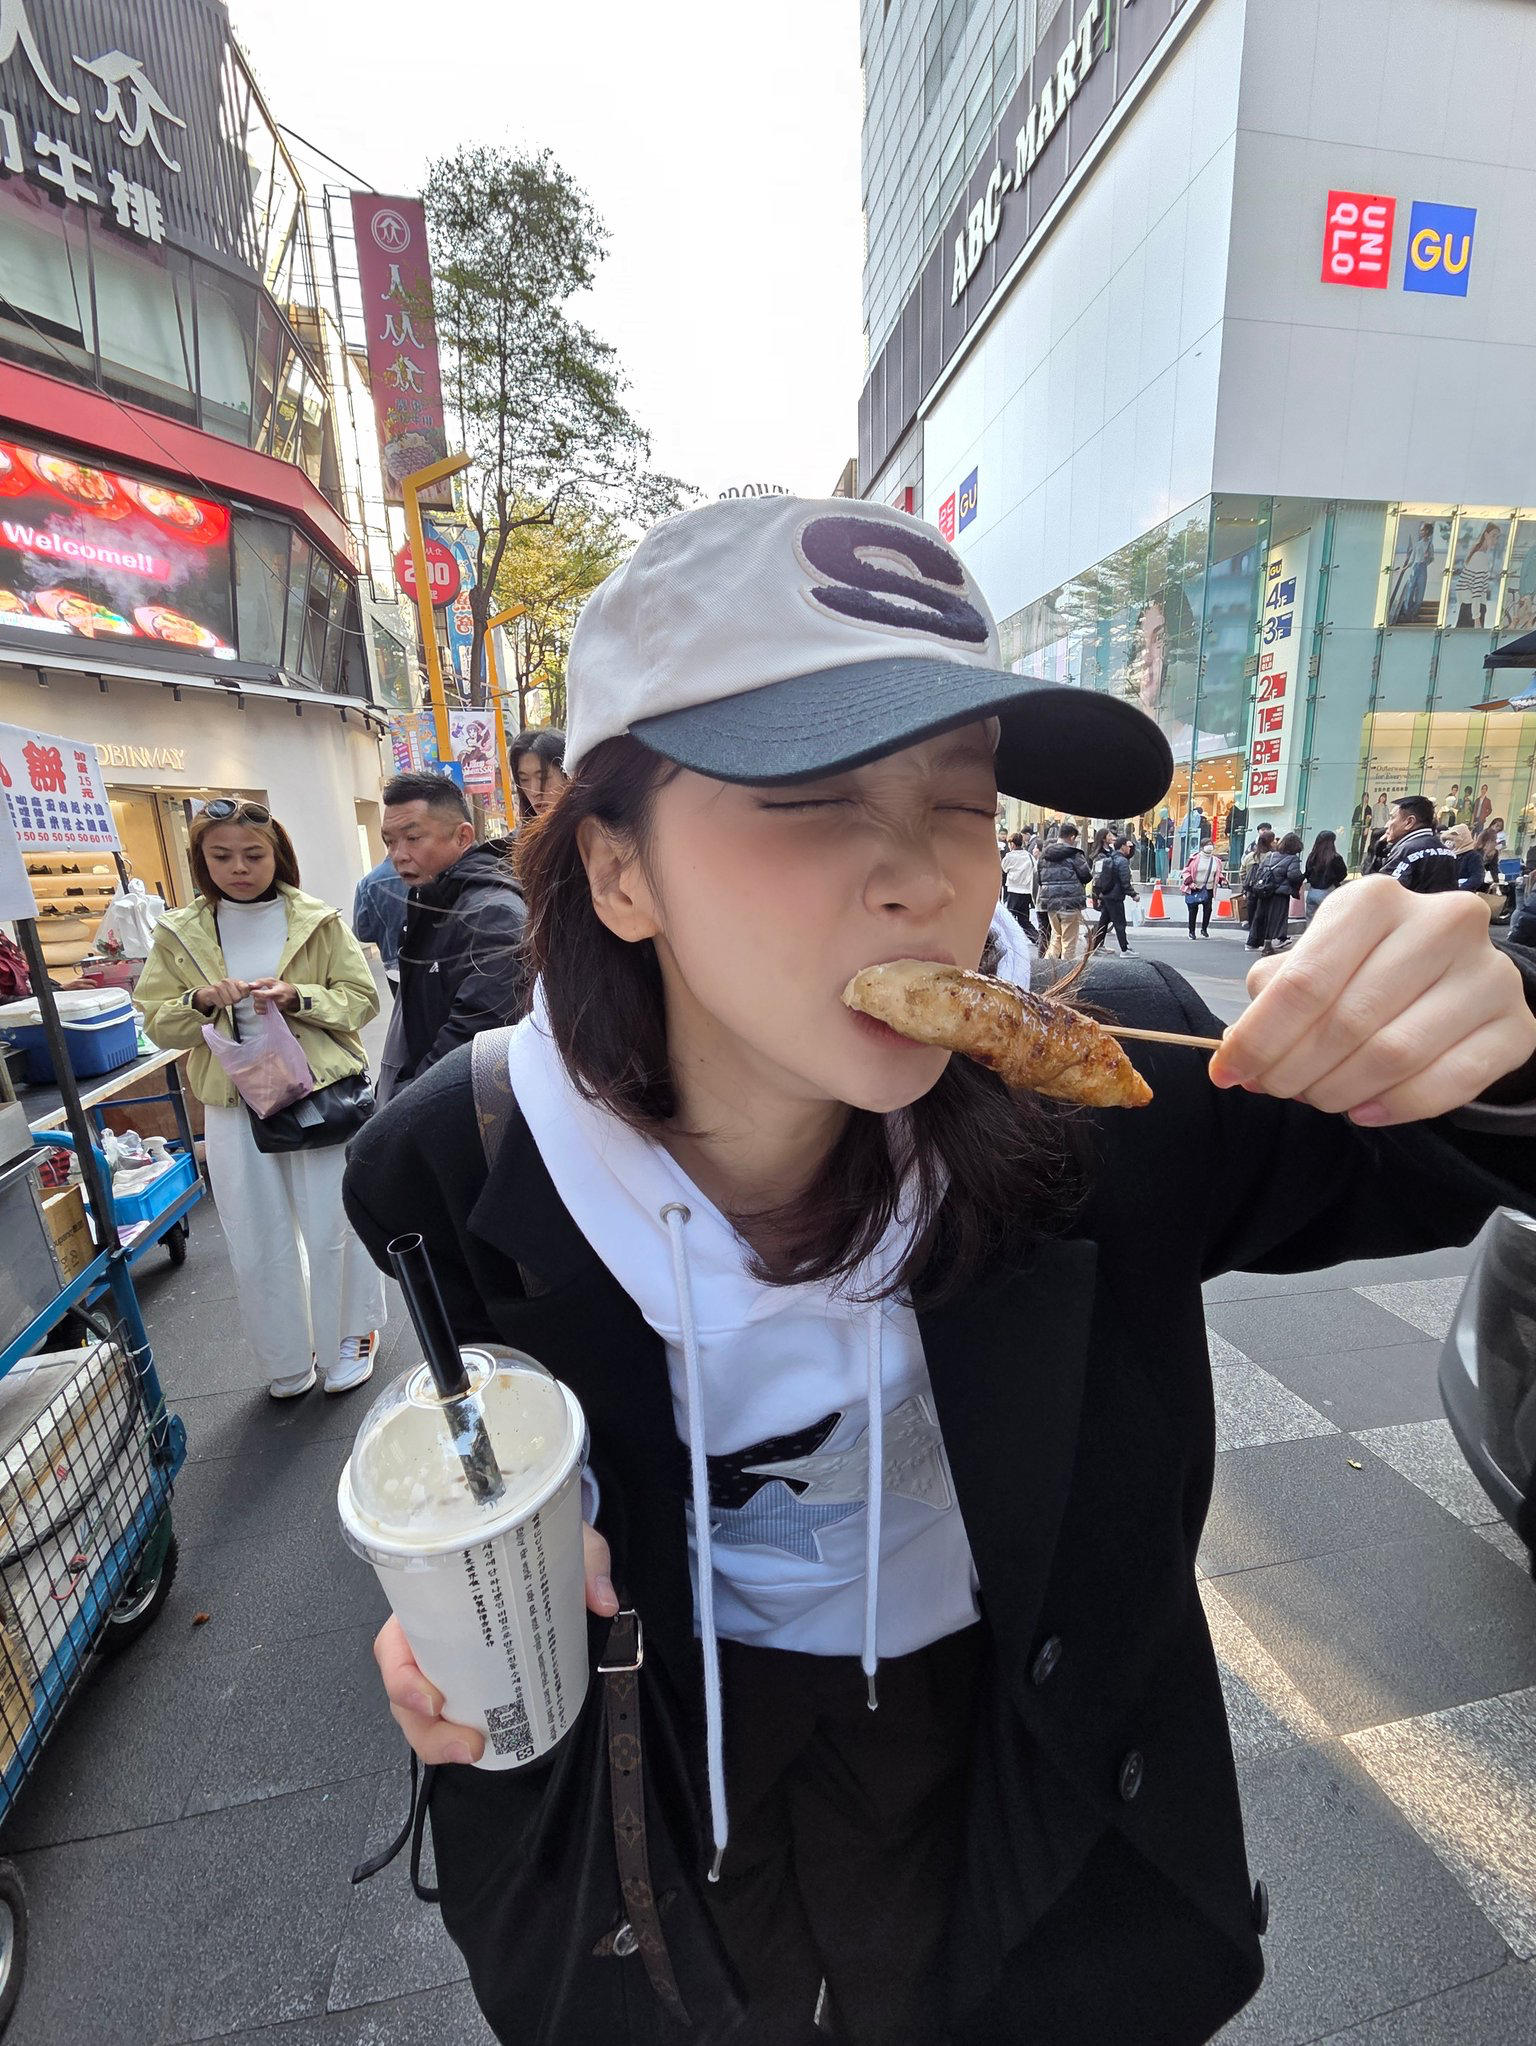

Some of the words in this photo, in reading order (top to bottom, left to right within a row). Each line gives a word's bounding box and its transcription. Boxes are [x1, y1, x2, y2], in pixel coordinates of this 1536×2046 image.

[951, 0, 1100, 307] ABC-MART
[1410, 227, 1471, 275] GU
[960, 483, 977, 518] GU
[1, 520, 155, 575] Welcome!!
[1269, 564, 1282, 577] GU
[1266, 582, 1288, 610] 4F
[1263, 616, 1284, 645] 3F
[1257, 675, 1278, 703] 2F
[1257, 708, 1271, 734] 1F
[96, 744, 185, 770] OBINMAY
[24, 831, 35, 841] 50
[38, 832, 49, 842] 50
[52, 832, 63, 842] 50
[64, 832, 76, 842] 50
[78, 833, 89, 843] 50
[1407, 850, 1424, 863] BY
